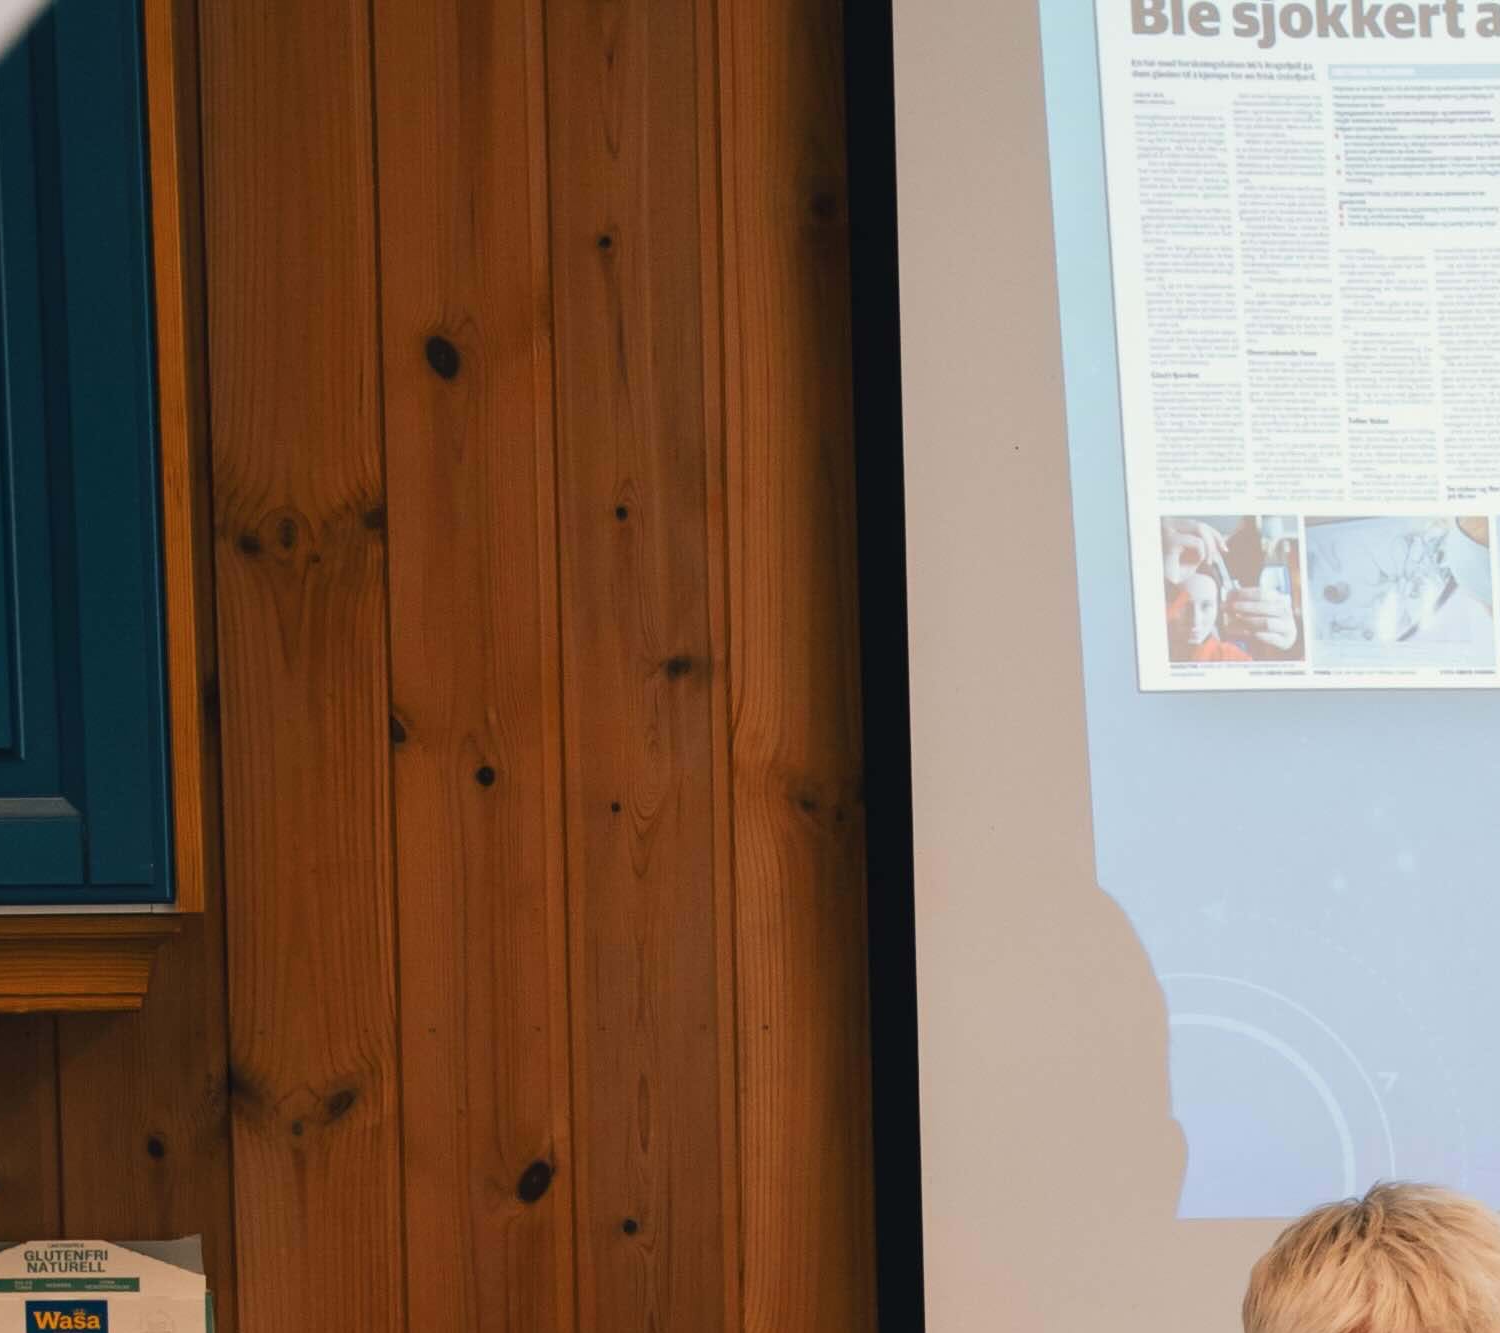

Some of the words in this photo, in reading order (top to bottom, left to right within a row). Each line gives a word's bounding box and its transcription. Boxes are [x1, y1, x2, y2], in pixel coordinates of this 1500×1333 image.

[1131, 0, 1220, 35] Ble
[24, 1250, 108, 1261] GLUTENFRI
[27, 1262, 106, 1273] NATURELL
[33, 1312, 101, 1329] Wasa
